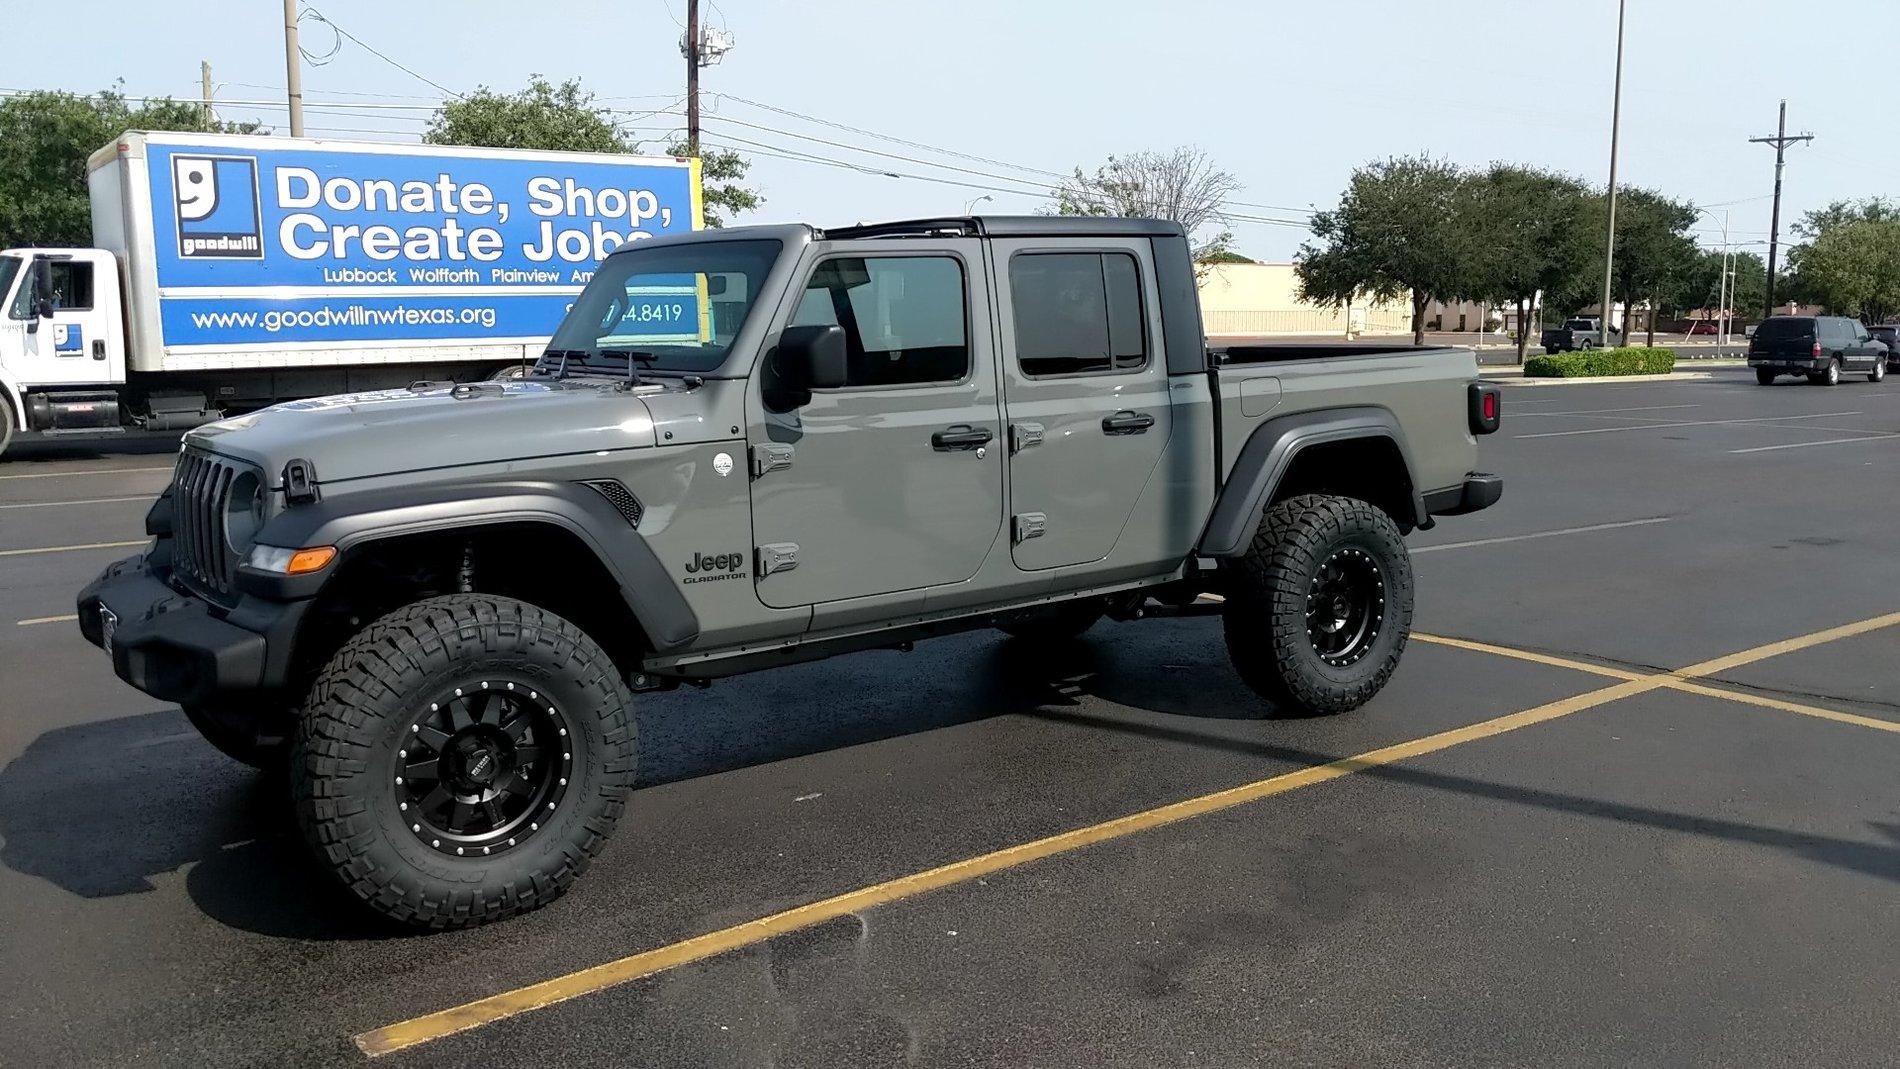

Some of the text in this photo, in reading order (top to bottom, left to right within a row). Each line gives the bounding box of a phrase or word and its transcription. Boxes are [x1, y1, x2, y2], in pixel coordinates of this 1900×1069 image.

[275, 166, 672, 229] Donate, Shop,
[183, 236, 258, 255] goodwill
[279, 213, 504, 261] Create
[324, 267, 397, 283] Lubbock
[409, 268, 480, 283] Wolfforth
[491, 268, 560, 283] Plainview
[191, 305, 496, 332] www.goodwillnwtexas.org
[685, 552, 743, 573] Jeep
[683, 572, 746, 585] GLADIATOR
